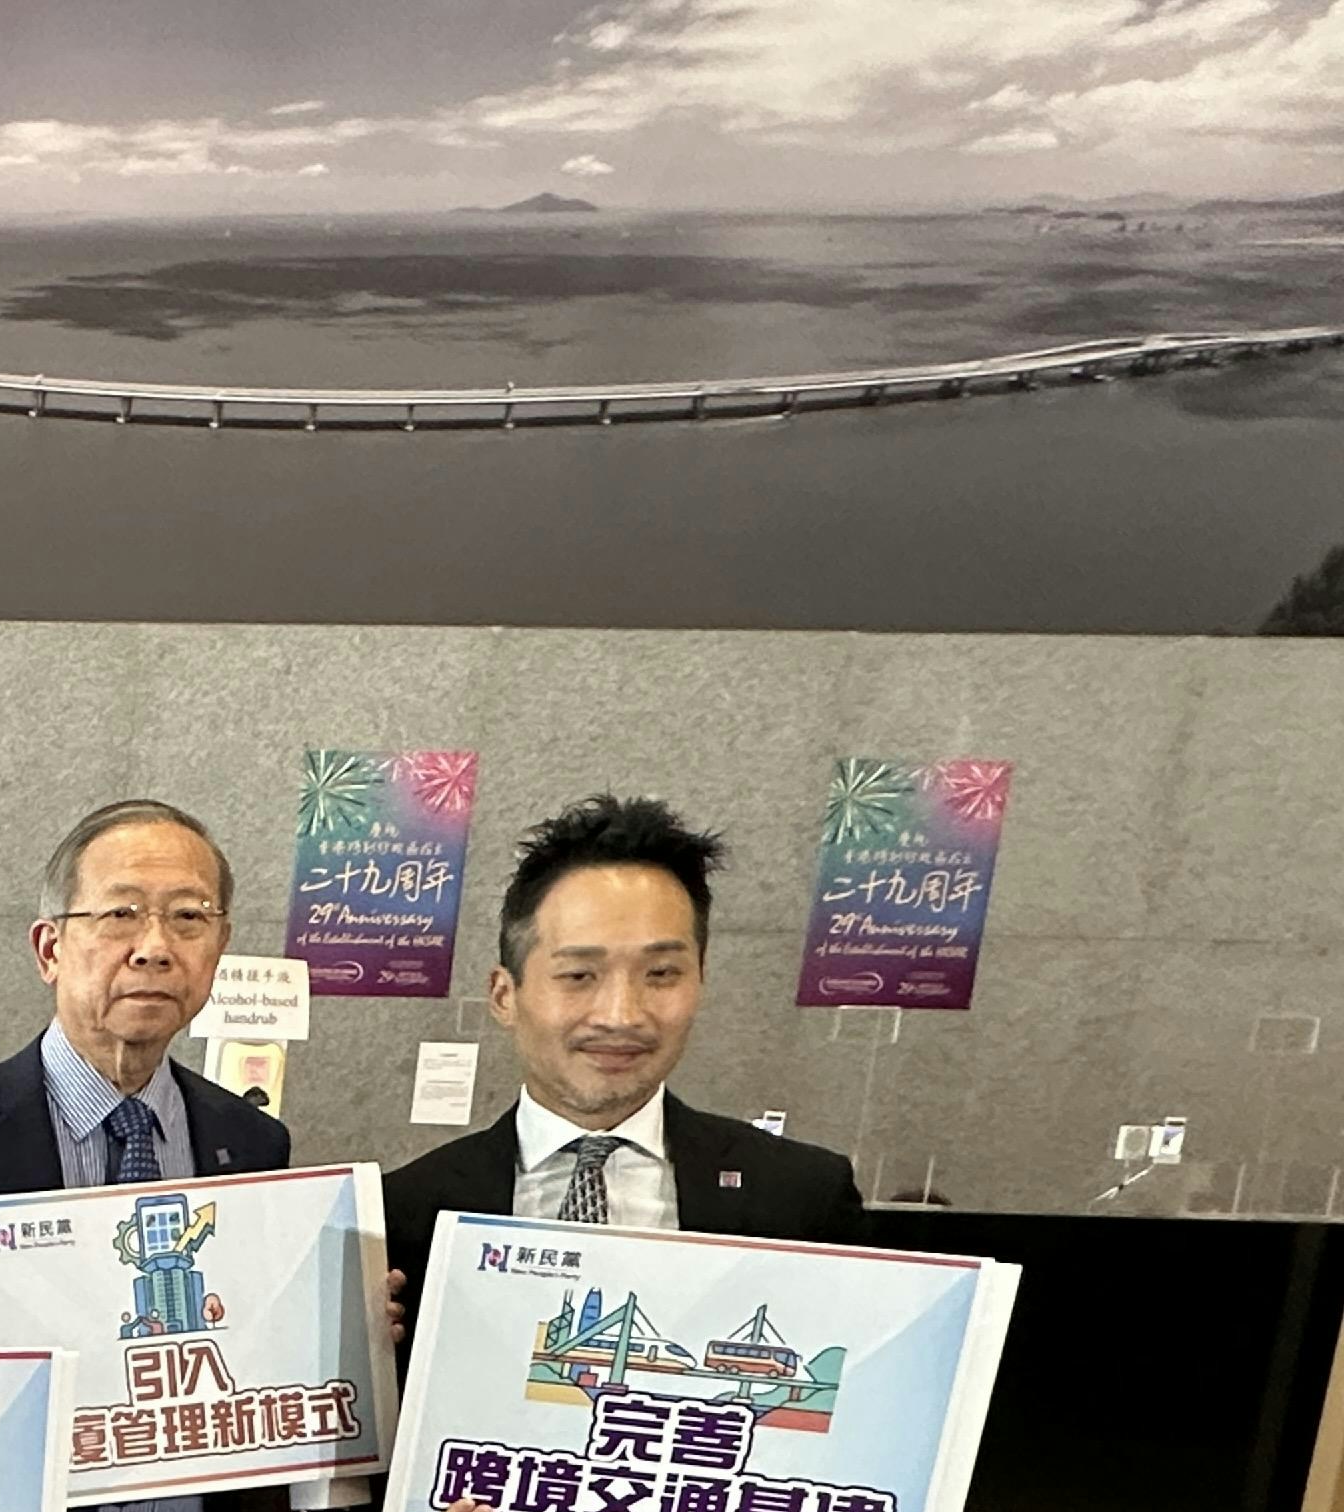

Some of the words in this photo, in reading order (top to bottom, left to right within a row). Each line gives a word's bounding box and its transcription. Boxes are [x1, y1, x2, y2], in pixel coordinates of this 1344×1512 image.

[300, 858, 454, 903] 二十九周年
[822, 868, 983, 913] 二十九周年
[337, 905, 434, 933] Anniversary
[859, 914, 959, 943] Anniversary
[224, 1011, 278, 1025] handrub
[21, 1218, 73, 1238] 新民黨
[516, 1246, 581, 1268] 新民黨
[131, 1346, 228, 1401] 引入
[592, 1399, 748, 1472] 完善
